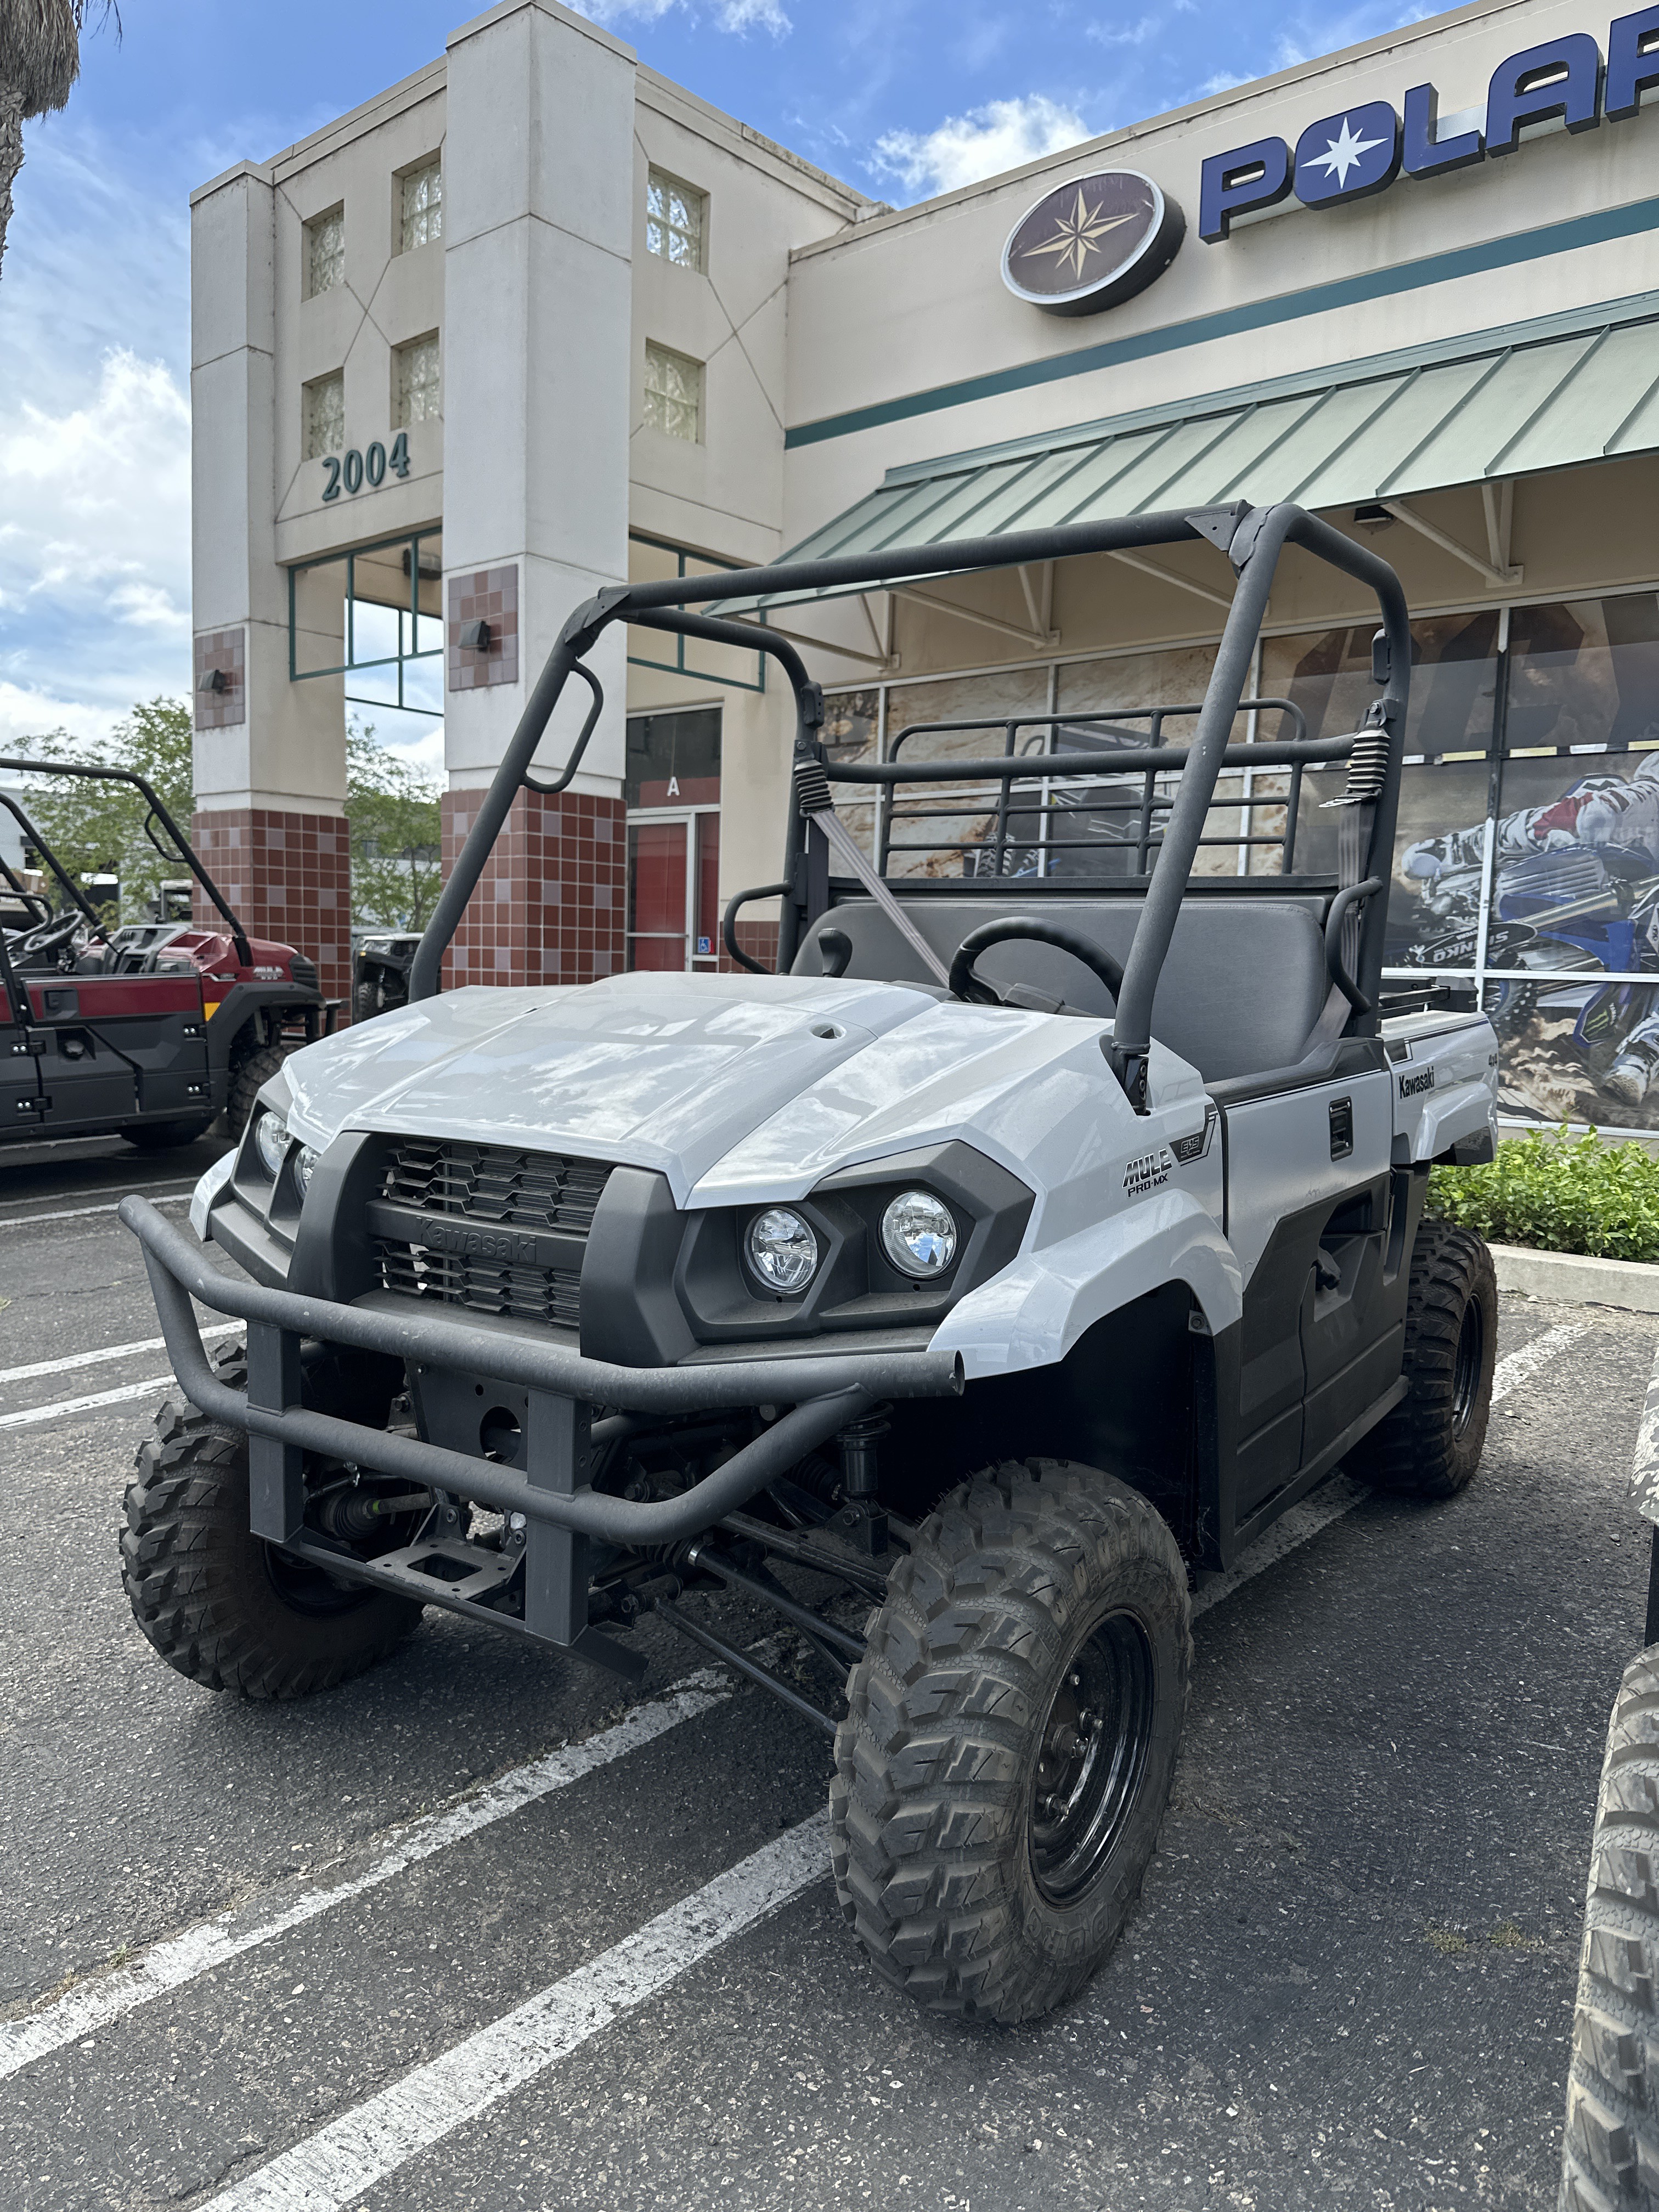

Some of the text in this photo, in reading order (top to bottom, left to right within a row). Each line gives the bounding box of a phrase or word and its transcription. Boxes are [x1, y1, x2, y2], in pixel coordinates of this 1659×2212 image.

[322, 432, 410, 502] 2004
[667, 776, 680, 797] A
[1399, 1065, 1435, 1099] Kawasaki
[1122, 1148, 1173, 1189] MULE
[416, 1216, 537, 1263] Kawasaki
